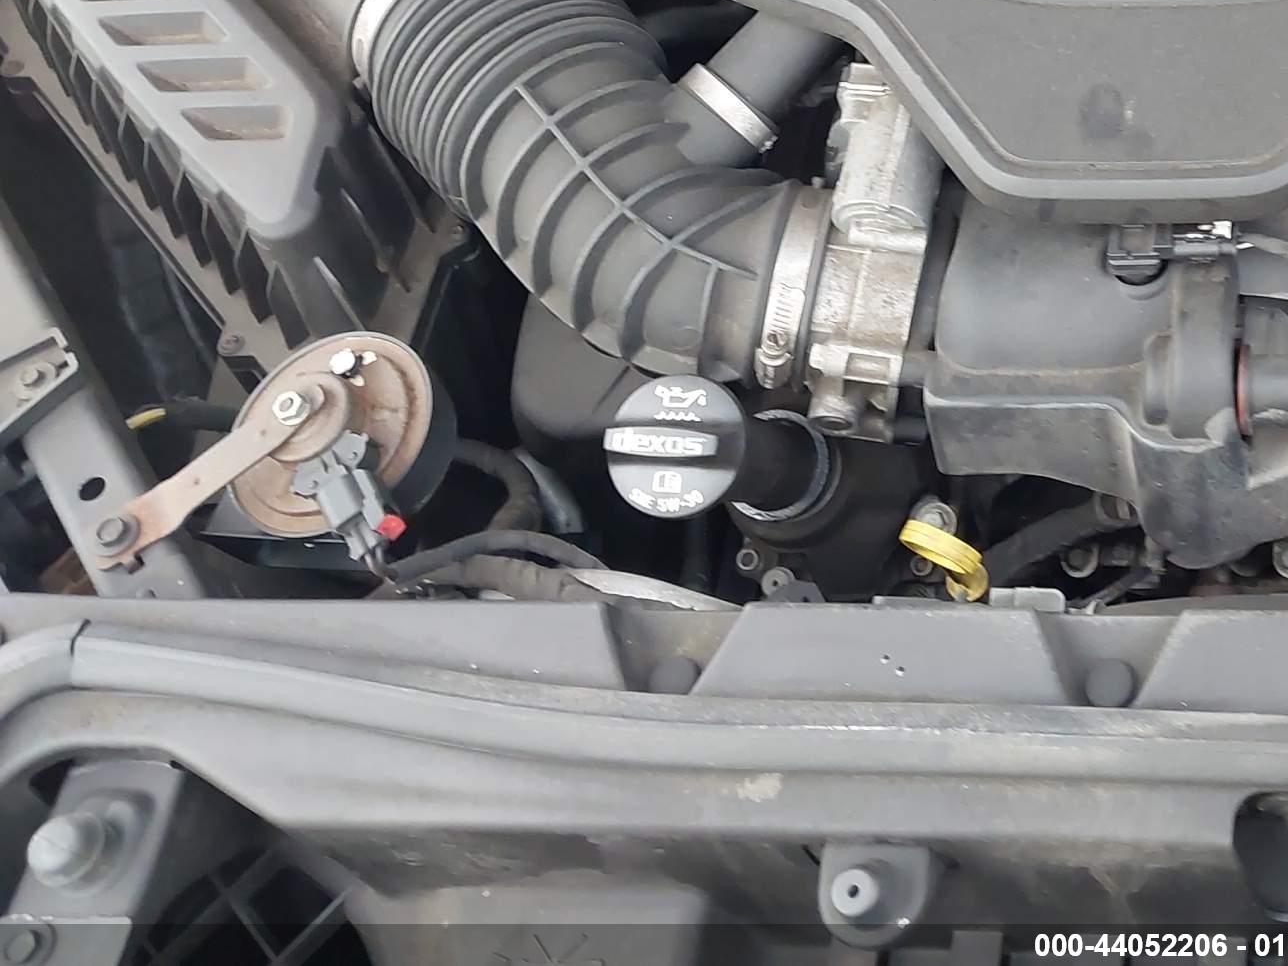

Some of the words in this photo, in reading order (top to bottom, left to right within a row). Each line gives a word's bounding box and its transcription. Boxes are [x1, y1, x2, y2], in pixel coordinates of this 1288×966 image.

[612, 427, 708, 454] dexos
[628, 488, 654, 510] SAE
[655, 489, 705, 513] 5W-30
